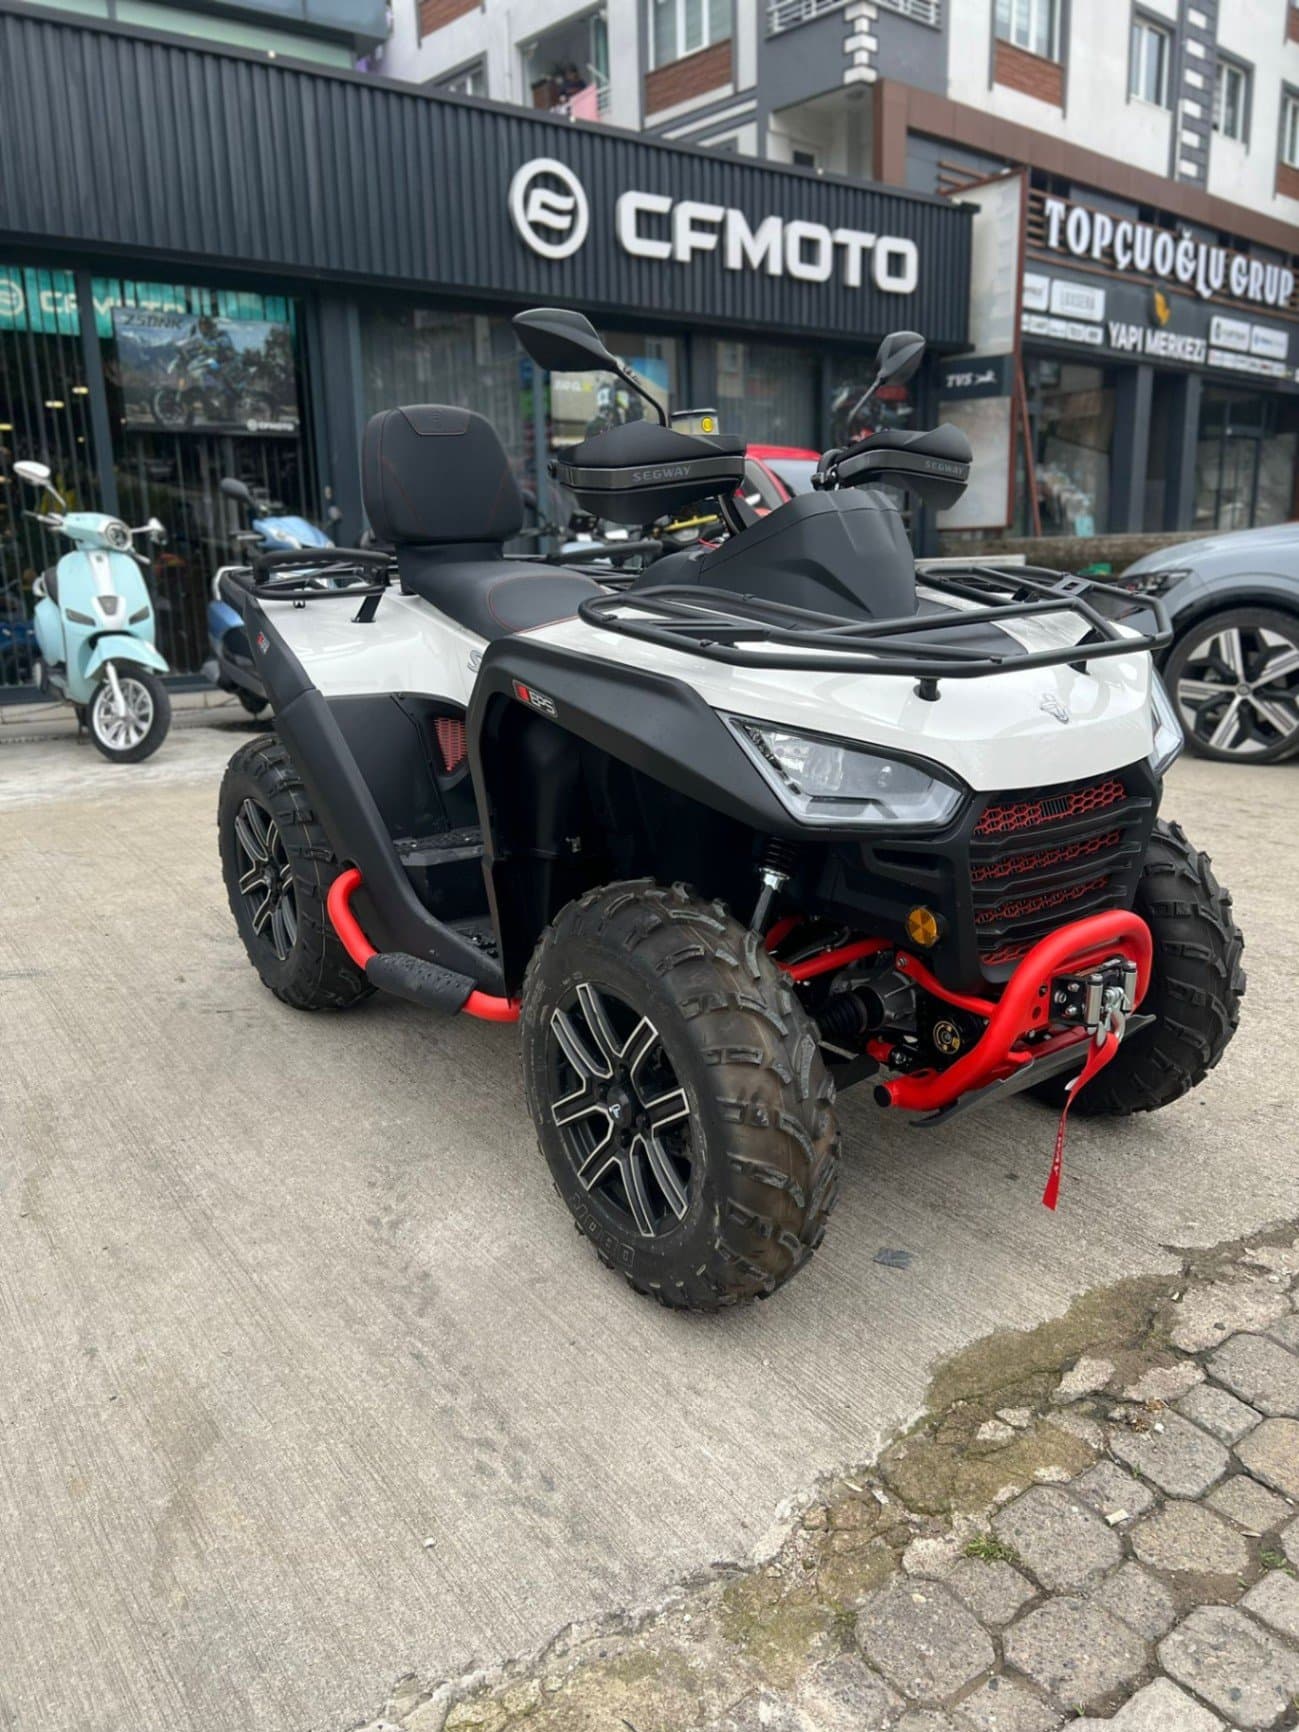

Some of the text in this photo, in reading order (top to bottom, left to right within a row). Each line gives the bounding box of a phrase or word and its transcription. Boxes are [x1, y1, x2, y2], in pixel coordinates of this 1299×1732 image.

[616, 190, 919, 294] CFMOTO
[1045, 198, 1295, 308] TOPÇUOĞLU GRUP
[1108, 320, 1144, 353] YAPI
[946, 371, 973, 388] TVS
[631, 463, 690, 483] SEGWAY
[925, 460, 965, 479] SEGWAY
